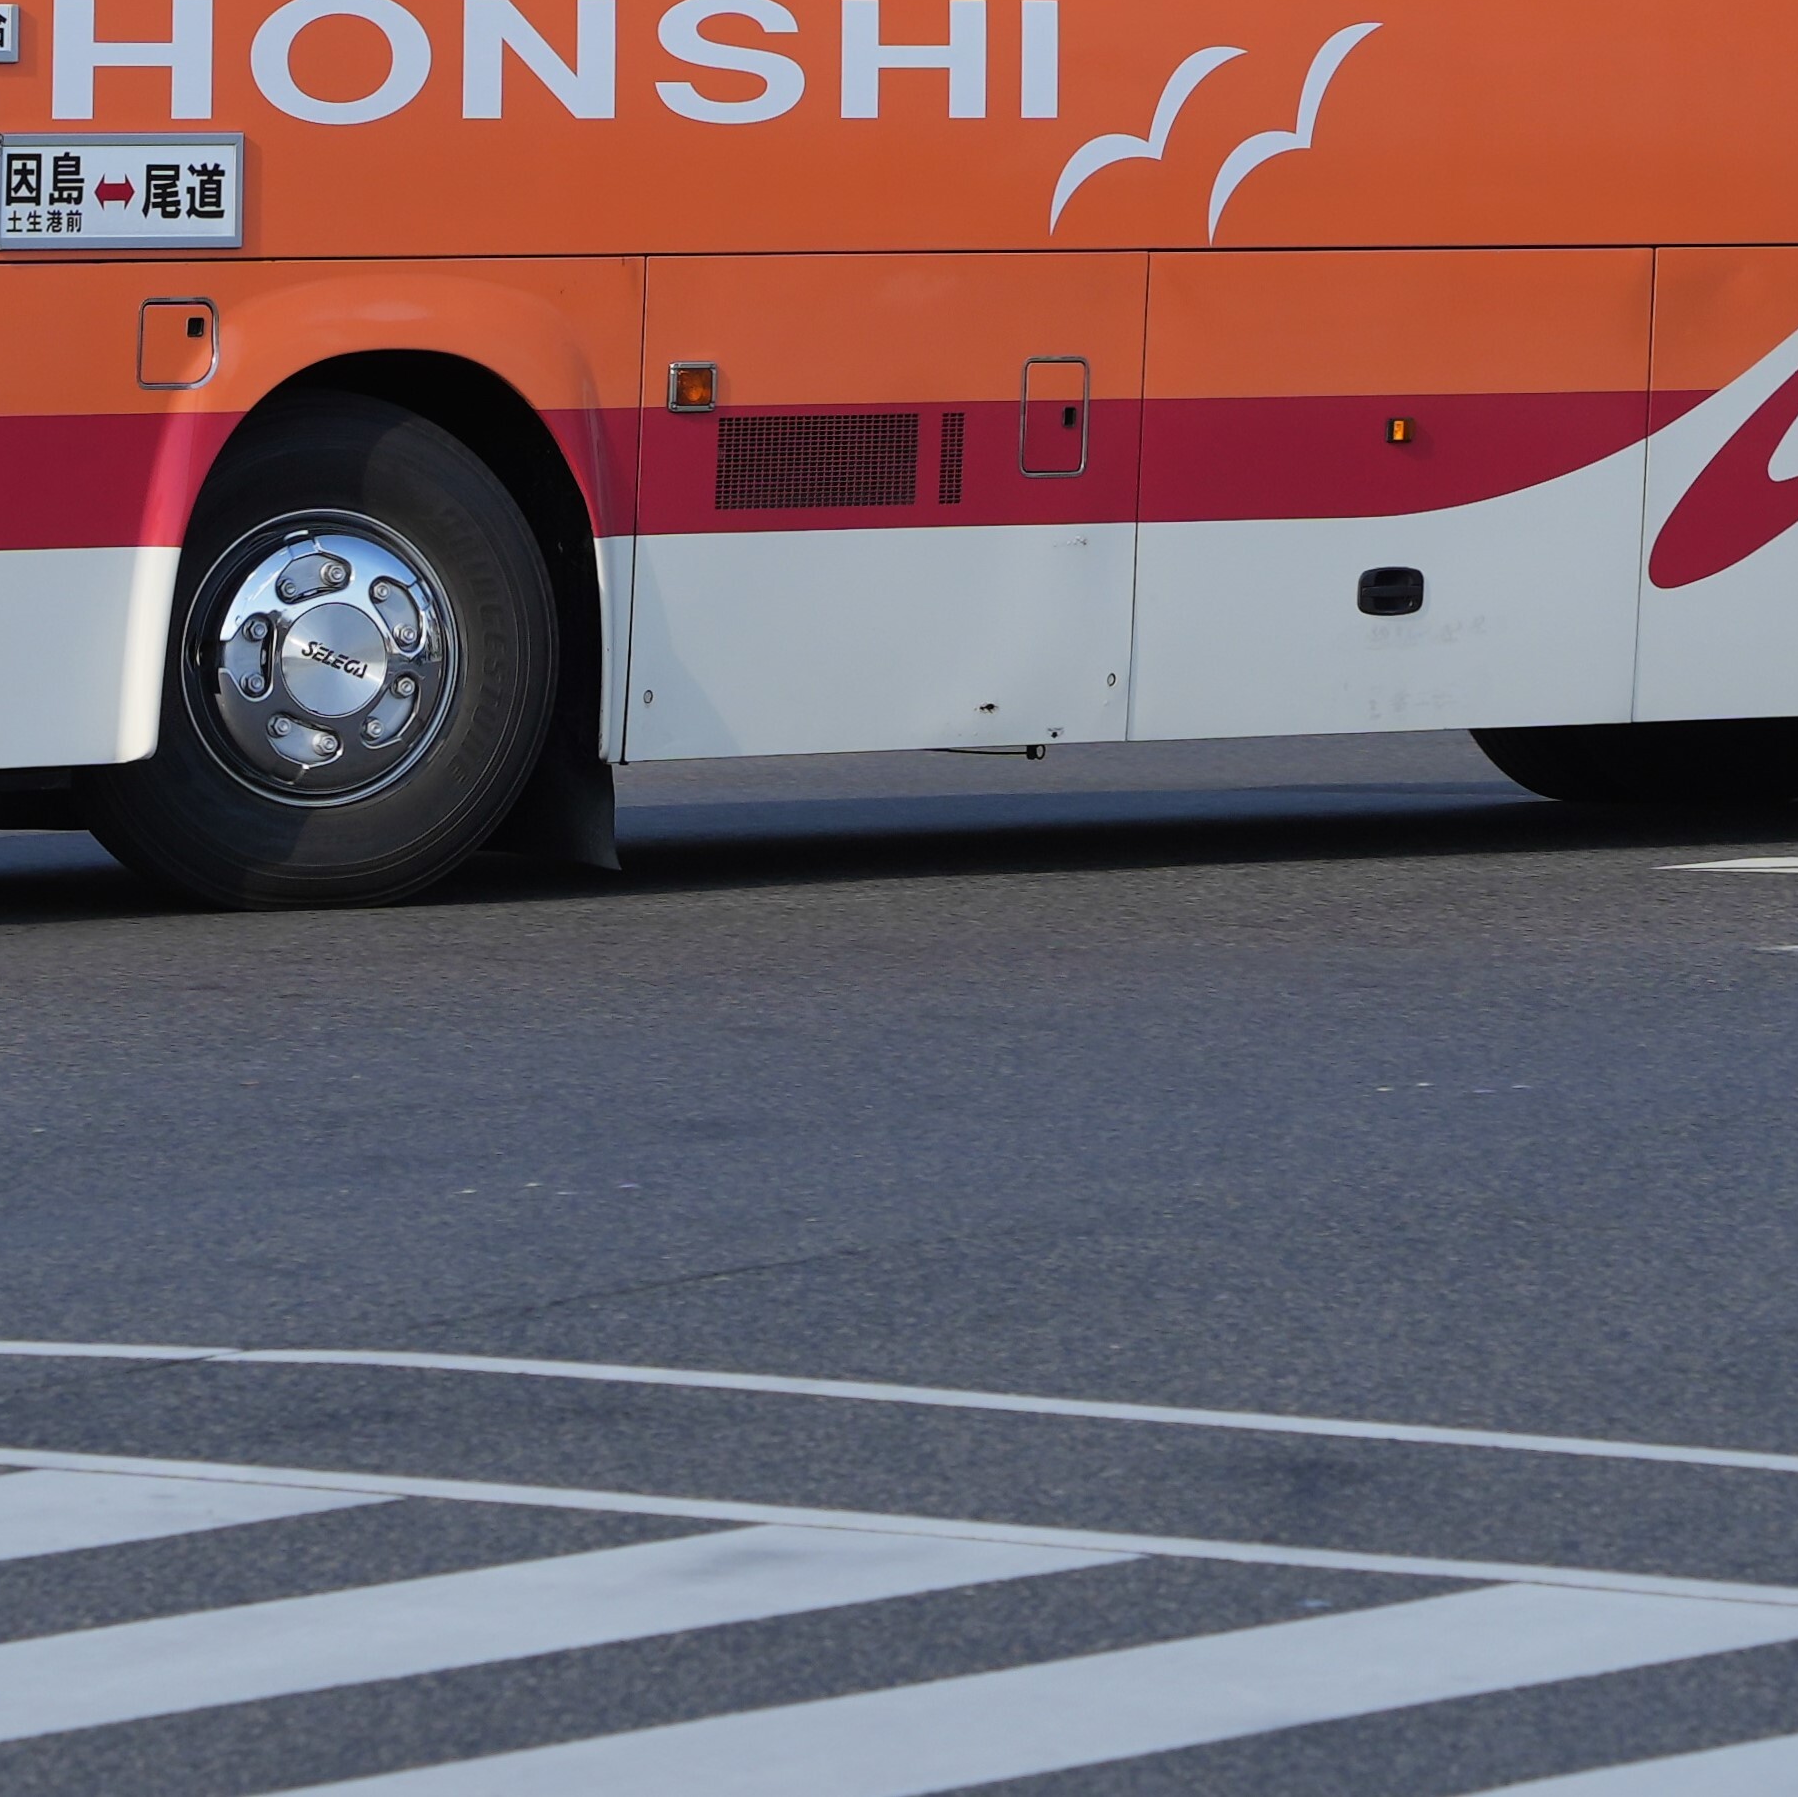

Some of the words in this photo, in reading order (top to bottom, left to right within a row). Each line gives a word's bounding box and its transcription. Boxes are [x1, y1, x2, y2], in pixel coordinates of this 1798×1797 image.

[4, 152, 86, 206] 因島
[140, 163, 226, 221] 尾道
[4, 209, 84, 235] 土生港前
[301, 640, 369, 680] SELEGA
